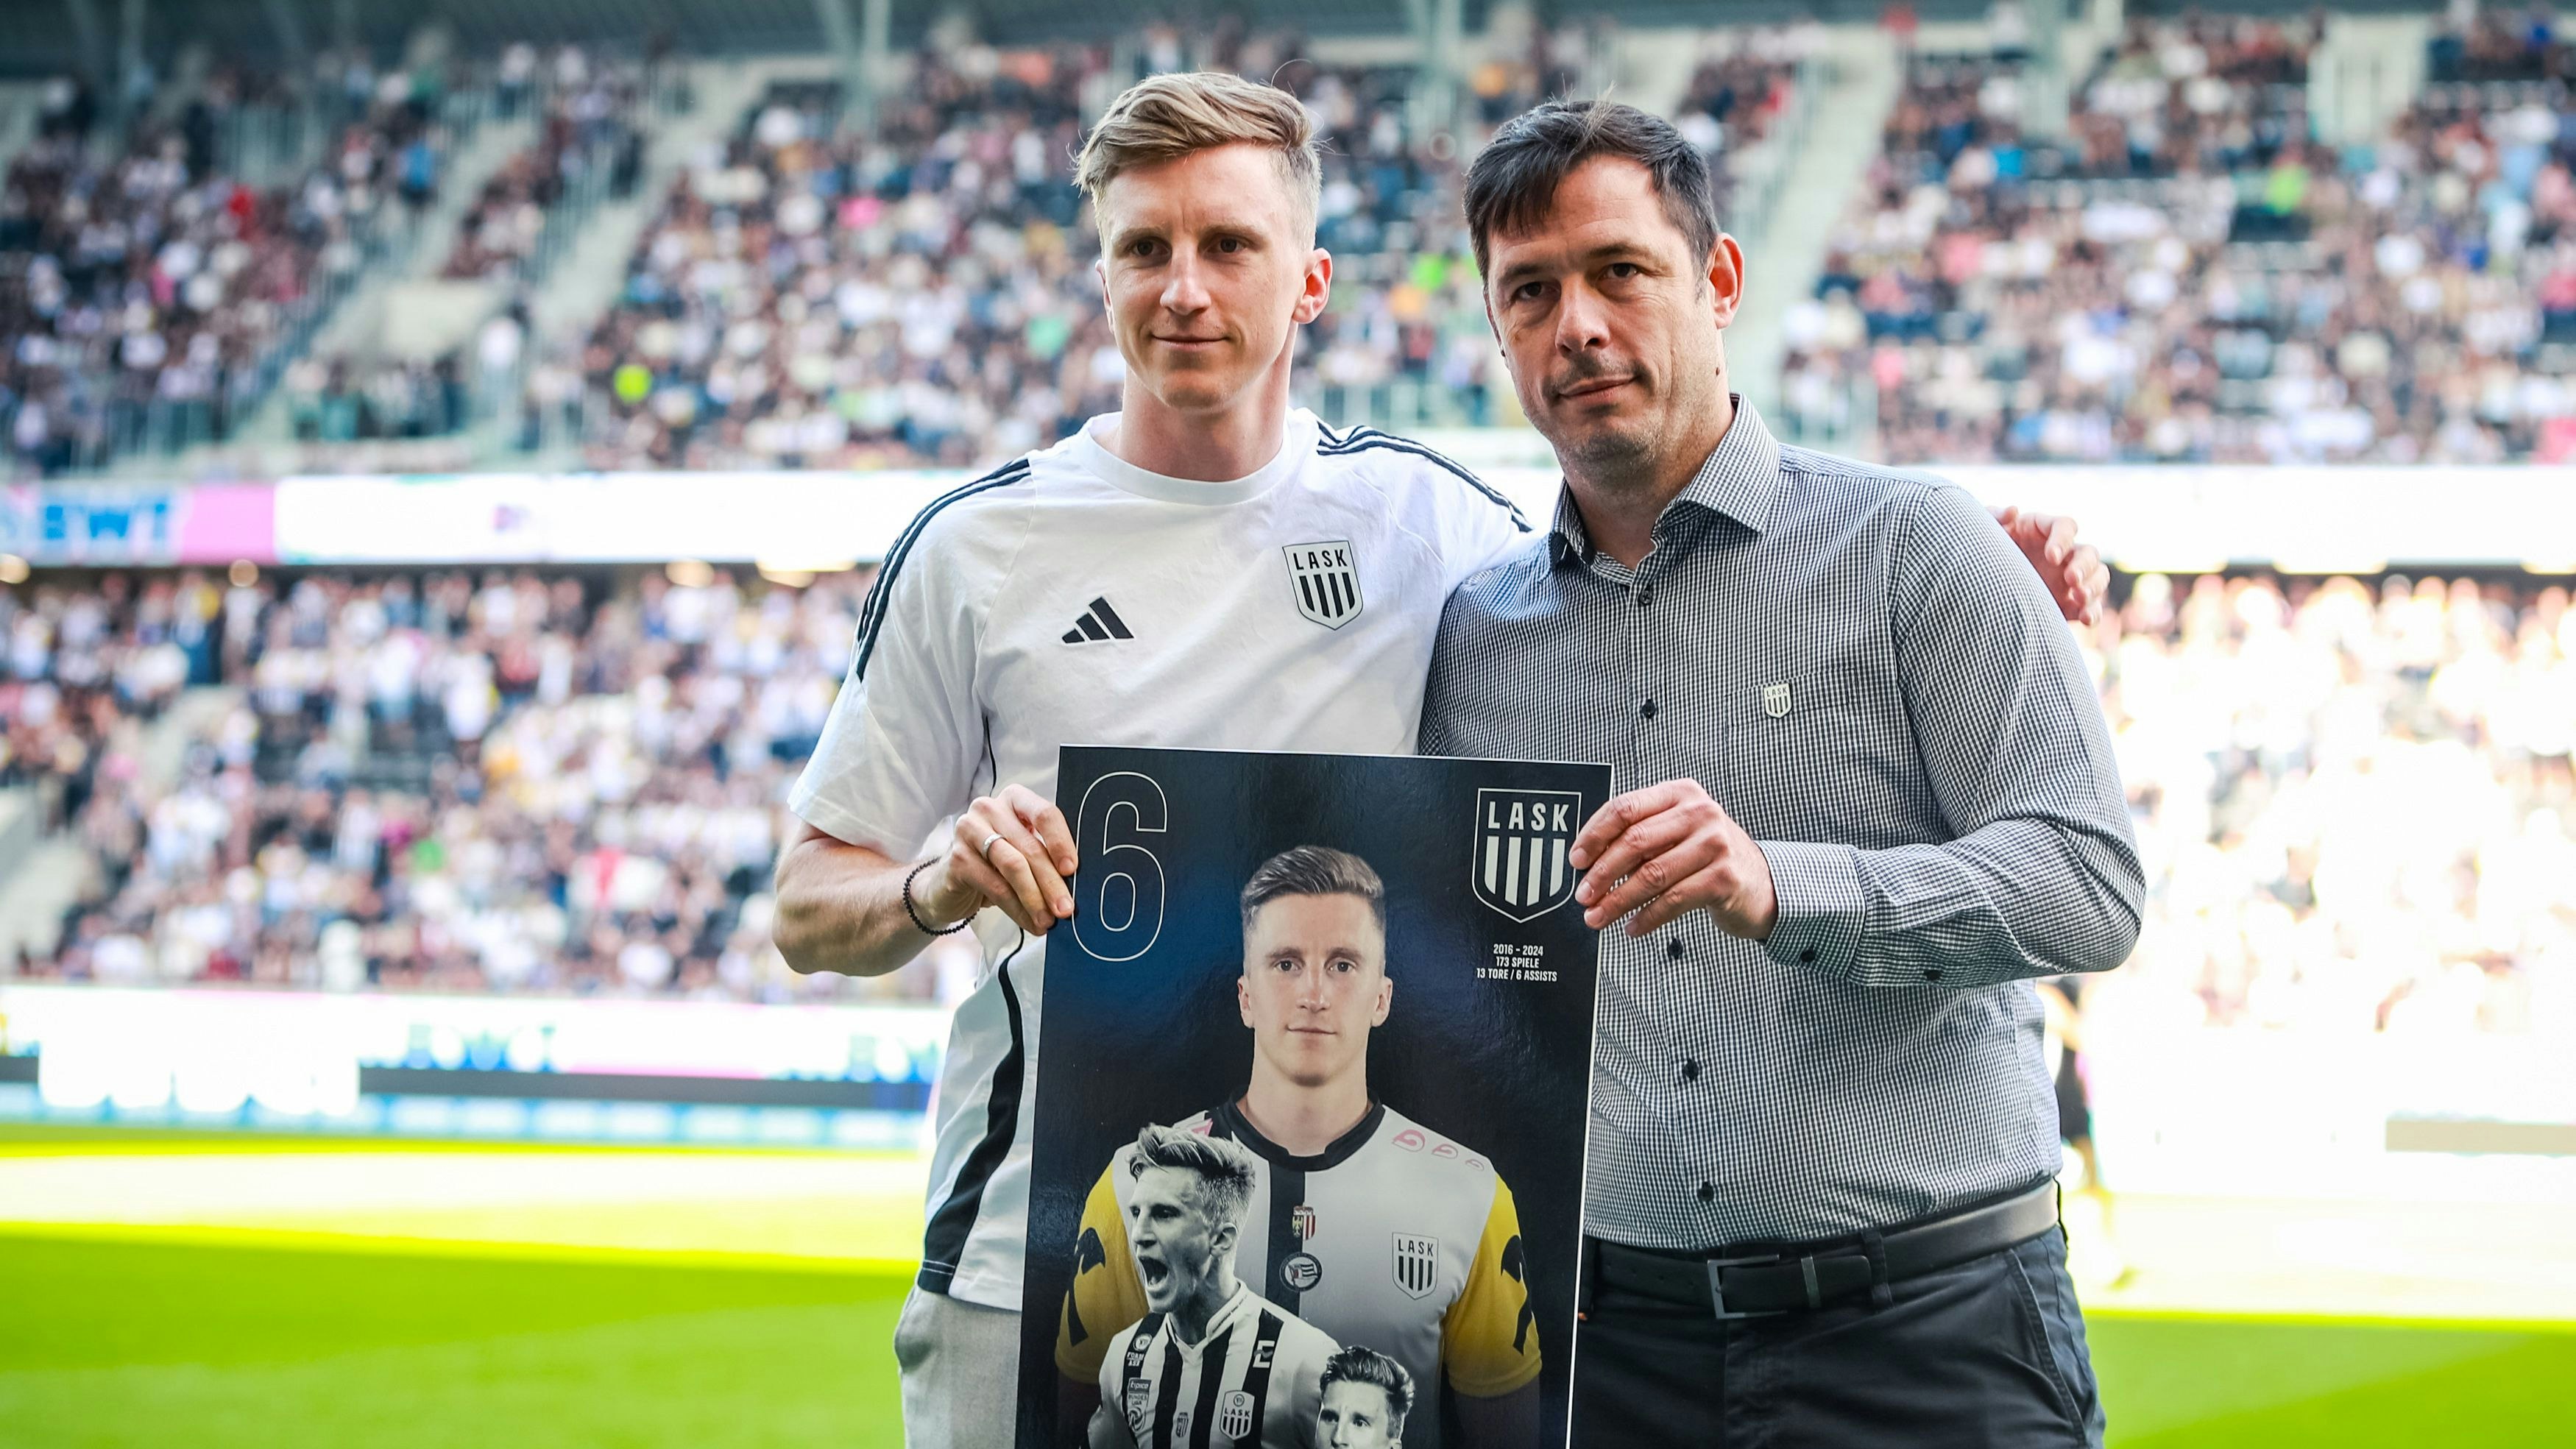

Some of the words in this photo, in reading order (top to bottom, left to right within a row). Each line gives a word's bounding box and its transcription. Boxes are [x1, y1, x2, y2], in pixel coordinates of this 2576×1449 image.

[1293, 549, 1348, 570] LASK
[1766, 687, 1788, 697] LASK
[1487, 801, 1569, 832] LASK
[1072, 771, 1168, 962] 6
[1493, 943, 1513, 954] 2016
[1522, 945, 1543, 956] 2024
[1496, 956, 1510, 967] 173
[1511, 957, 1540, 968] SPIELE
[1476, 968, 1486, 979] 13
[1487, 968, 1509, 979] TORE
[1515, 970, 1522, 980] 6
[1524, 971, 1557, 982] ASSISTS
[1398, 1239, 1434, 1257] LASK
[1224, 1407, 1250, 1418] LASK
